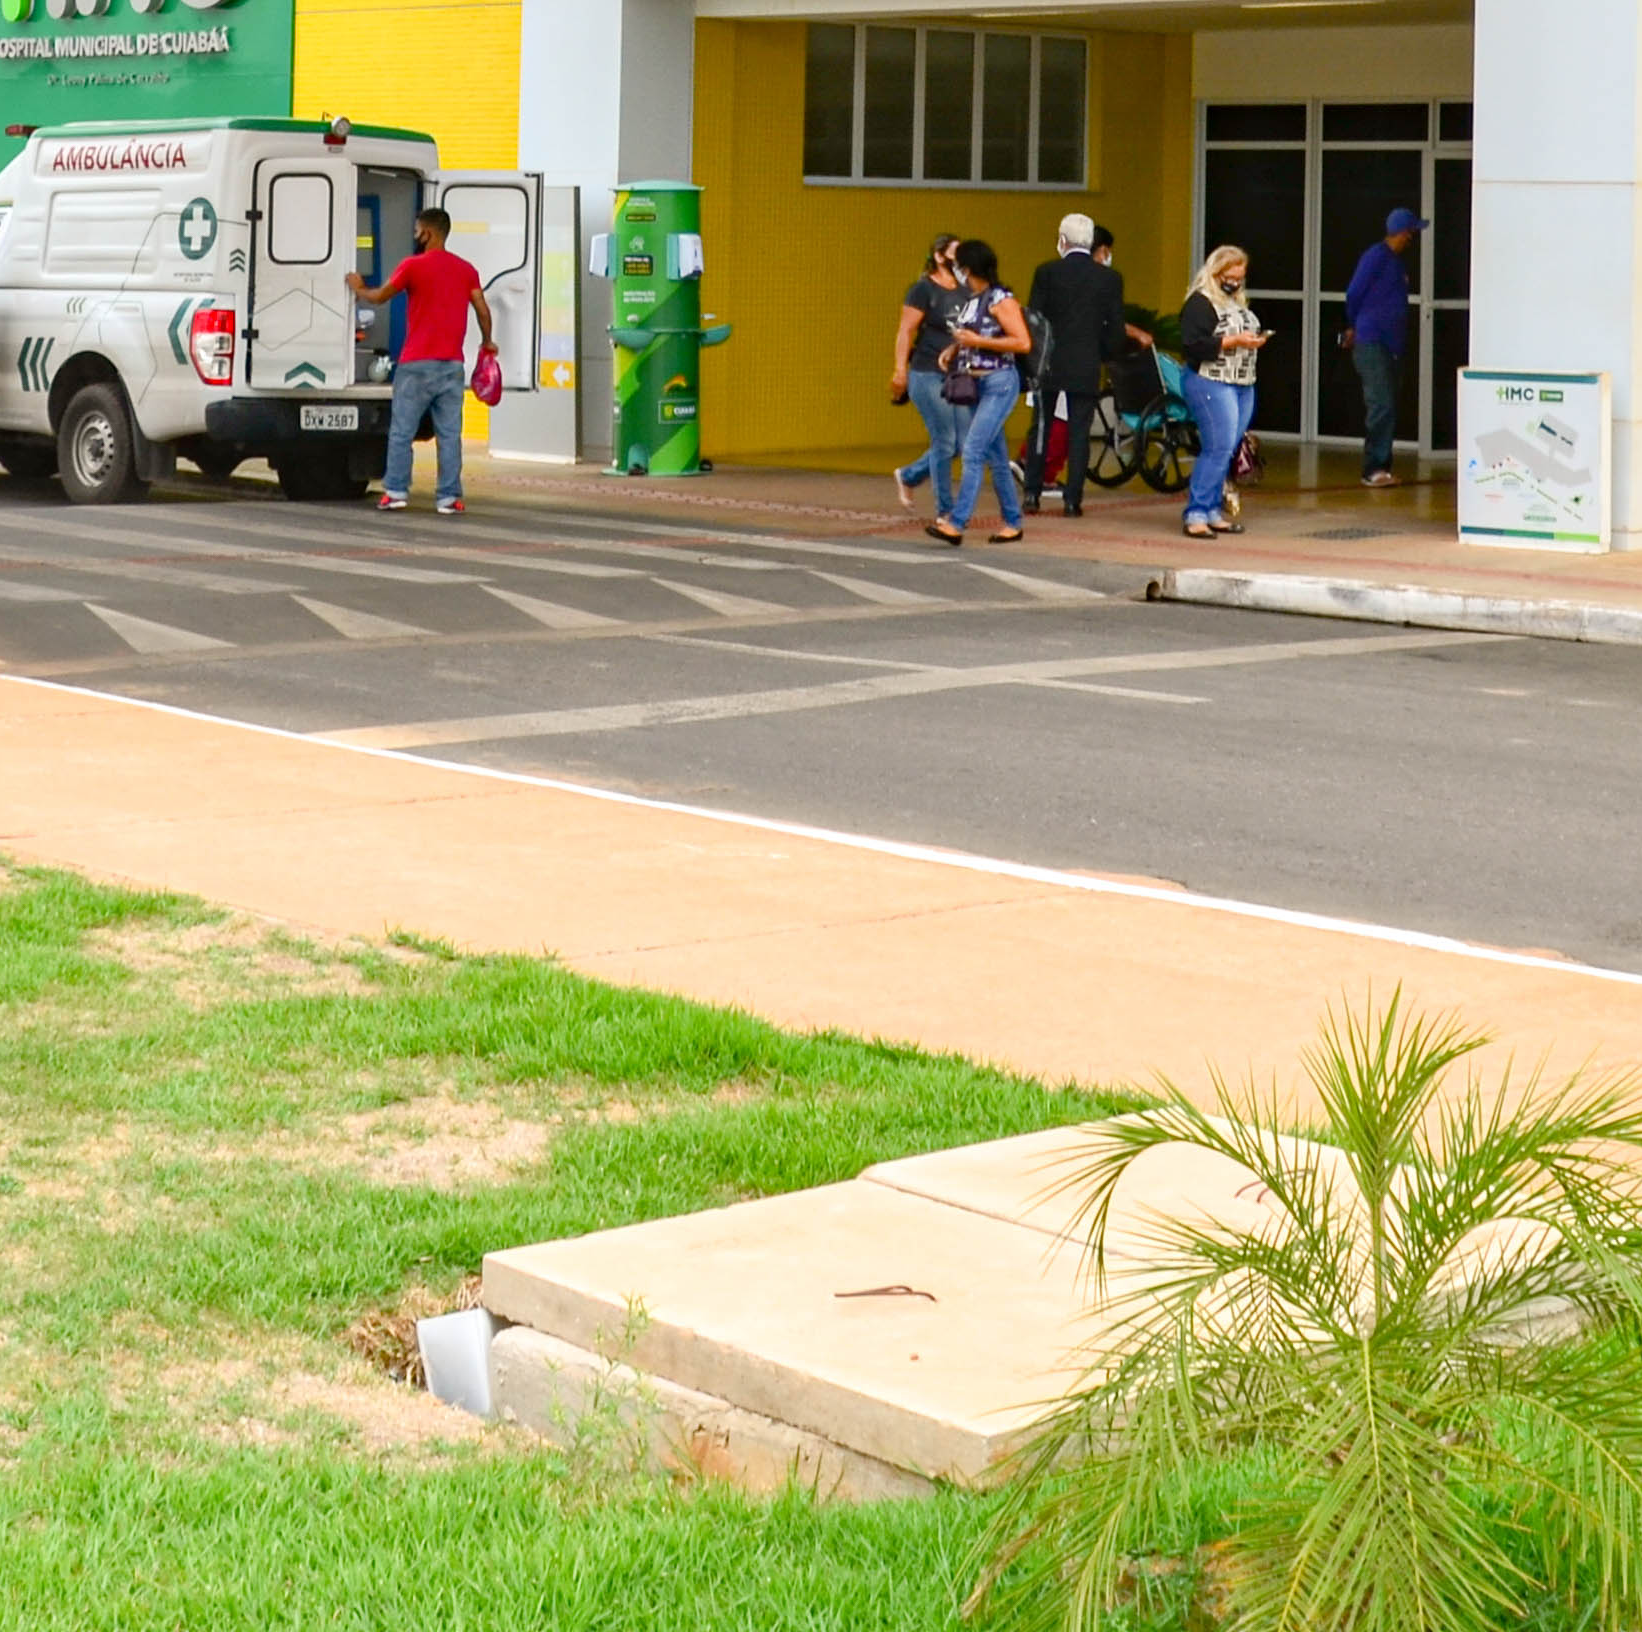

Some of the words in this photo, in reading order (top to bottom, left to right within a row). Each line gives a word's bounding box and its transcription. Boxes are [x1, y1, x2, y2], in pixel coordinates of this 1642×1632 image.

[54, 33, 134, 58] MUNICIPAL
[136, 32, 159, 55] DE
[160, 25, 230, 54] CUIABÁ
[52, 136, 187, 172] AMBULÂNCIA
